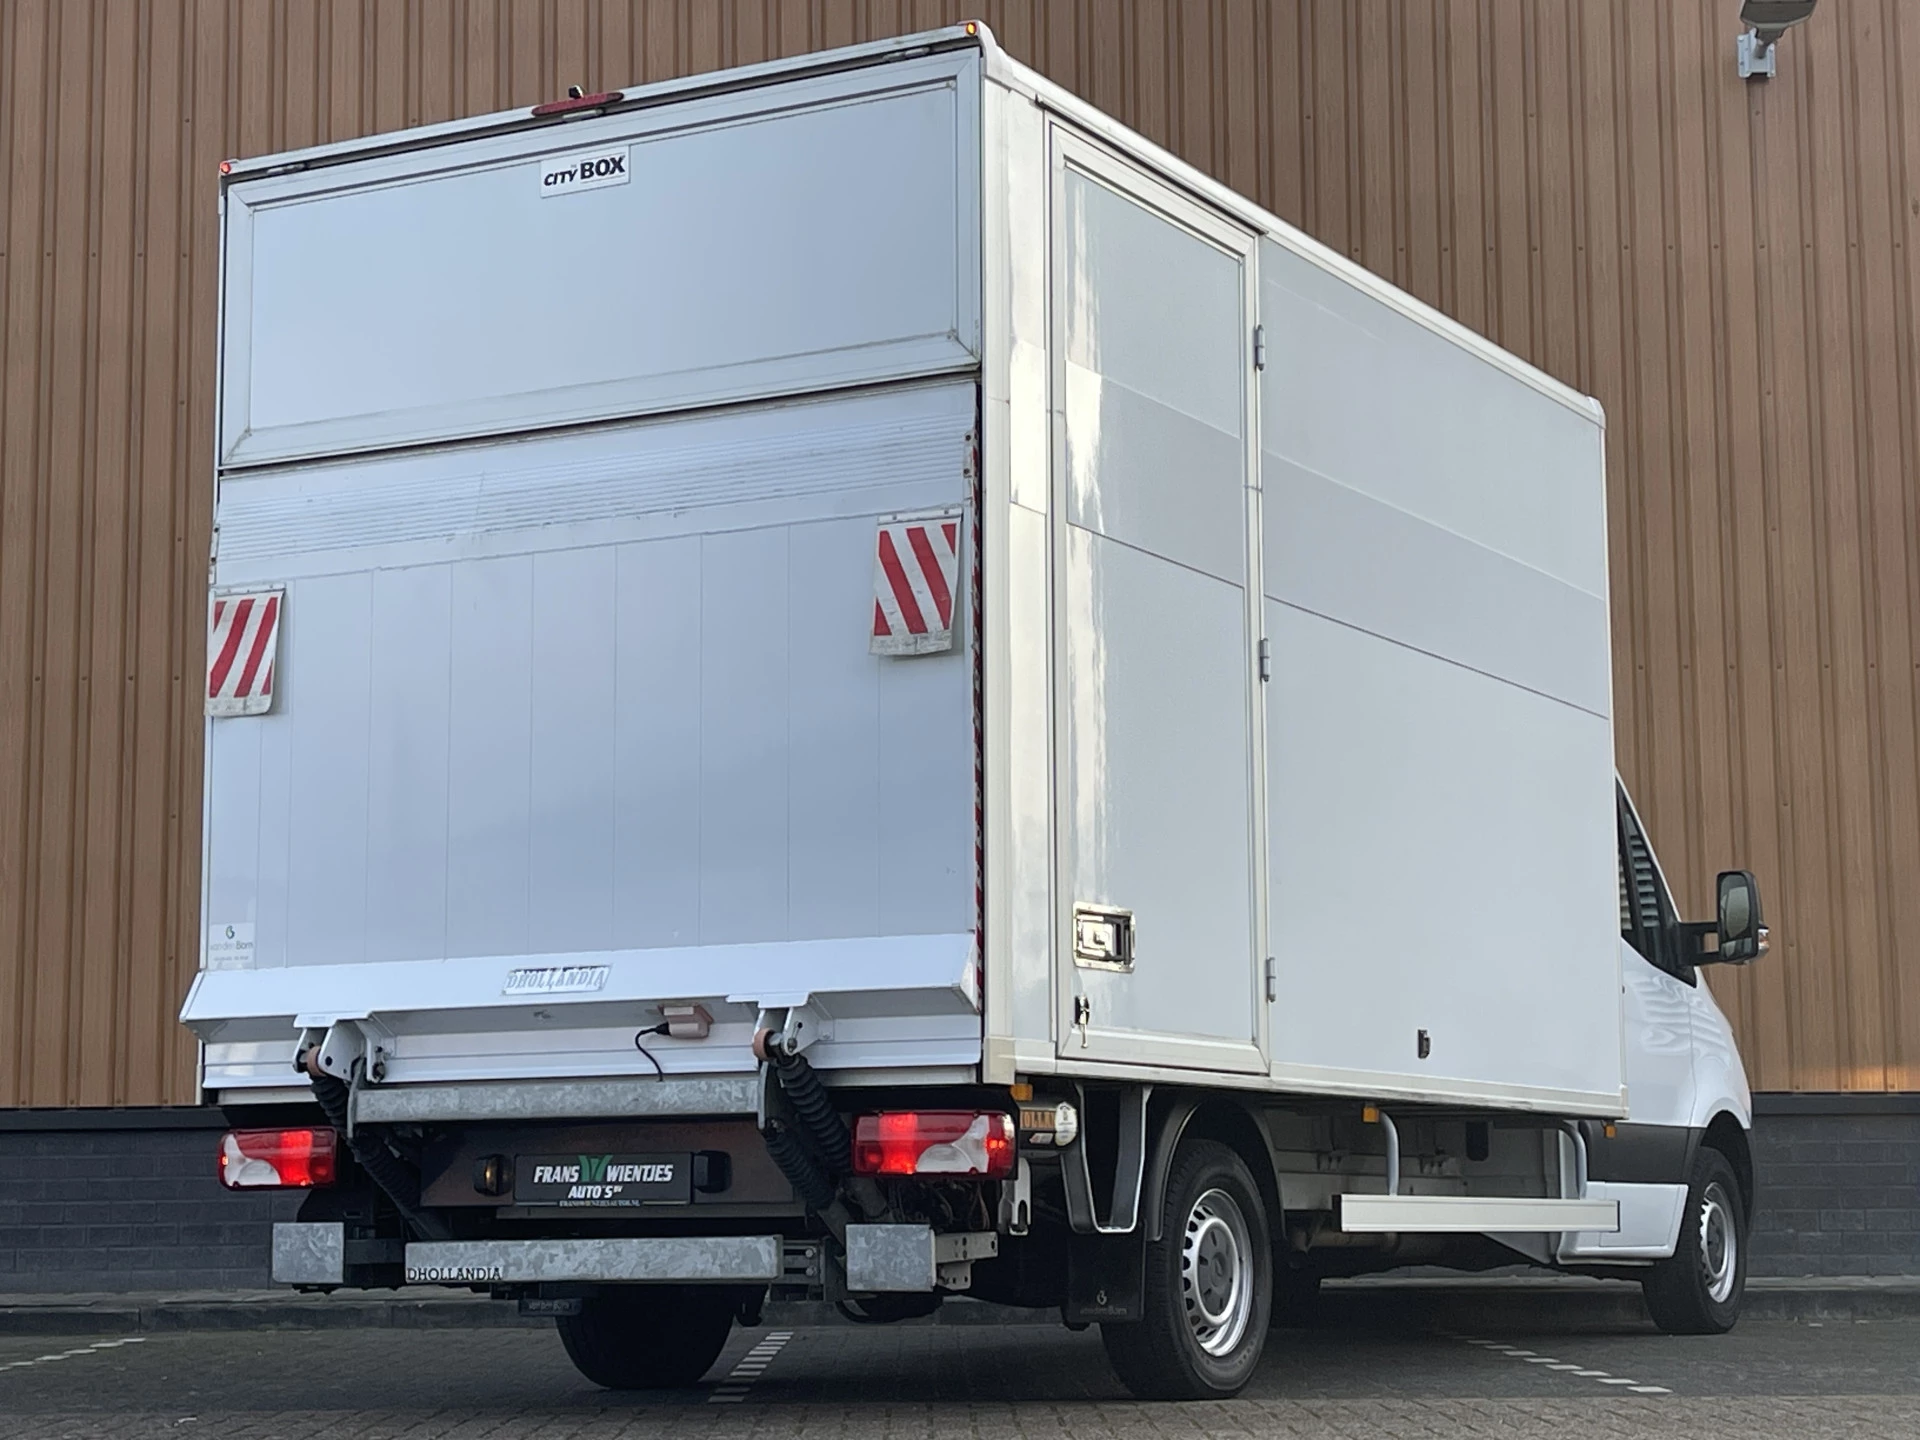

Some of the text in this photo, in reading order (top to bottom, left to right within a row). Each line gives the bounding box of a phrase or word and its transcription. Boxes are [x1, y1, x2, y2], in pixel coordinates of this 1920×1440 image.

[544, 155, 626, 187] CITY BOX
[505, 967, 605, 989] DHOLLANDIA
[533, 1165, 580, 1183] FRANS
[606, 1164, 674, 1182] WIENTJES
[407, 1267, 501, 1281] DHOLLANDIA
